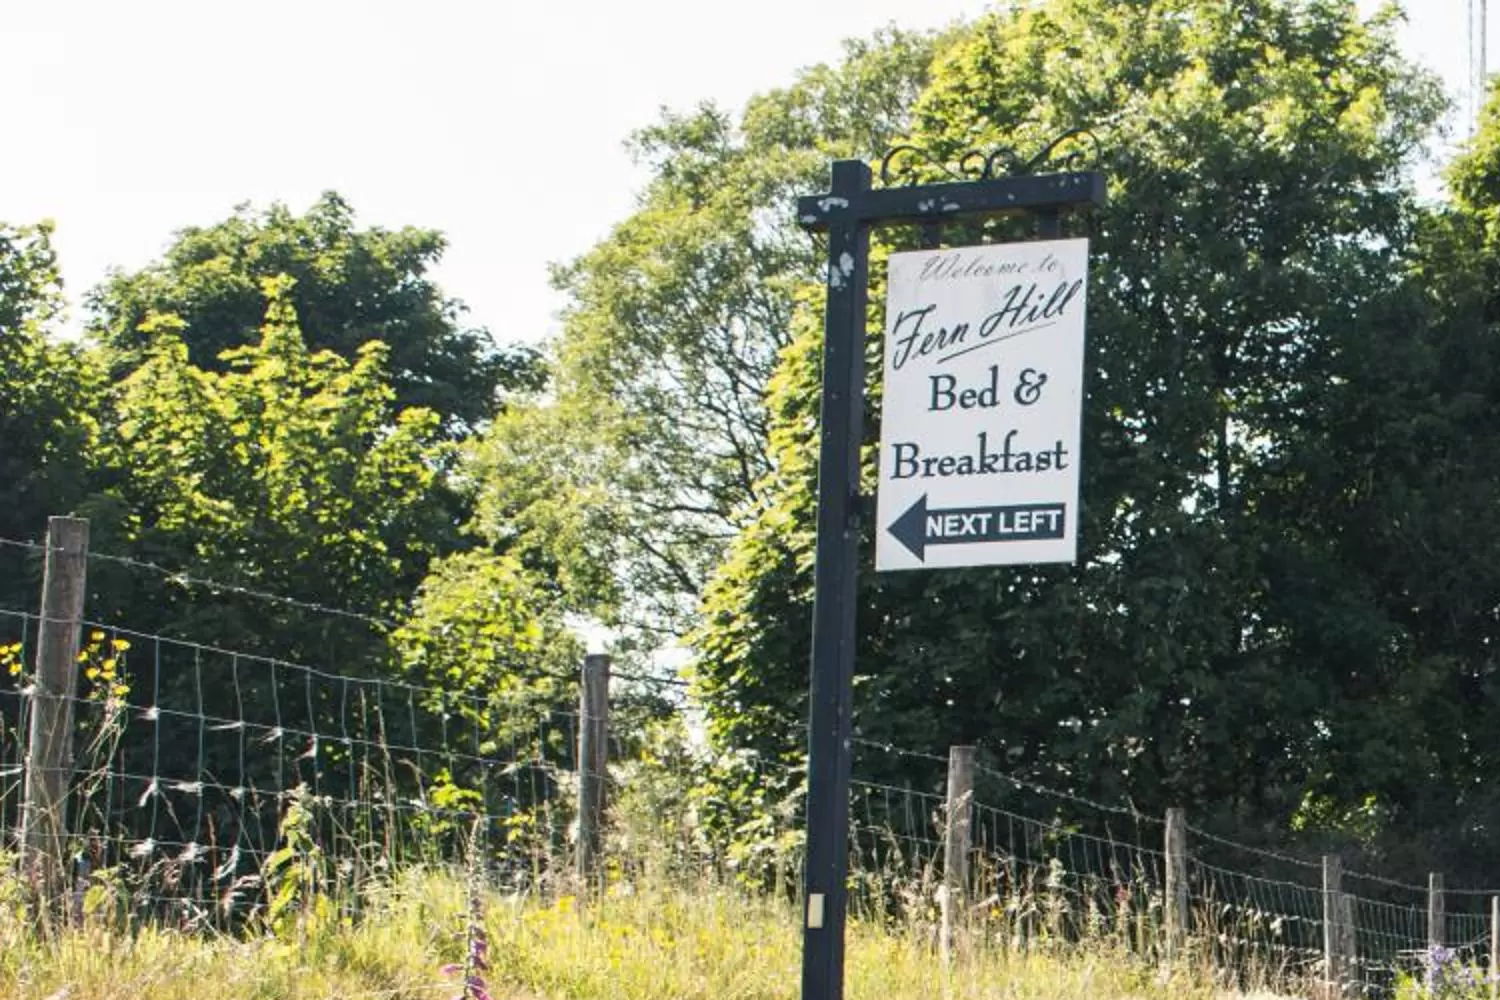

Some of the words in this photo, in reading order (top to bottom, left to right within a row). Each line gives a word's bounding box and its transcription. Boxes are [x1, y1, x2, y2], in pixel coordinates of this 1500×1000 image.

[919, 253, 1028, 281] Welcome
[1037, 253, 1058, 273] to
[893, 304, 969, 371] Fern
[979, 278, 1083, 338] Hill
[928, 364, 1001, 411] Bed
[1013, 368, 1048, 405] &
[890, 429, 1069, 480] Breakfast
[925, 513, 993, 538] NEXT
[999, 509, 1062, 534] LEFT
